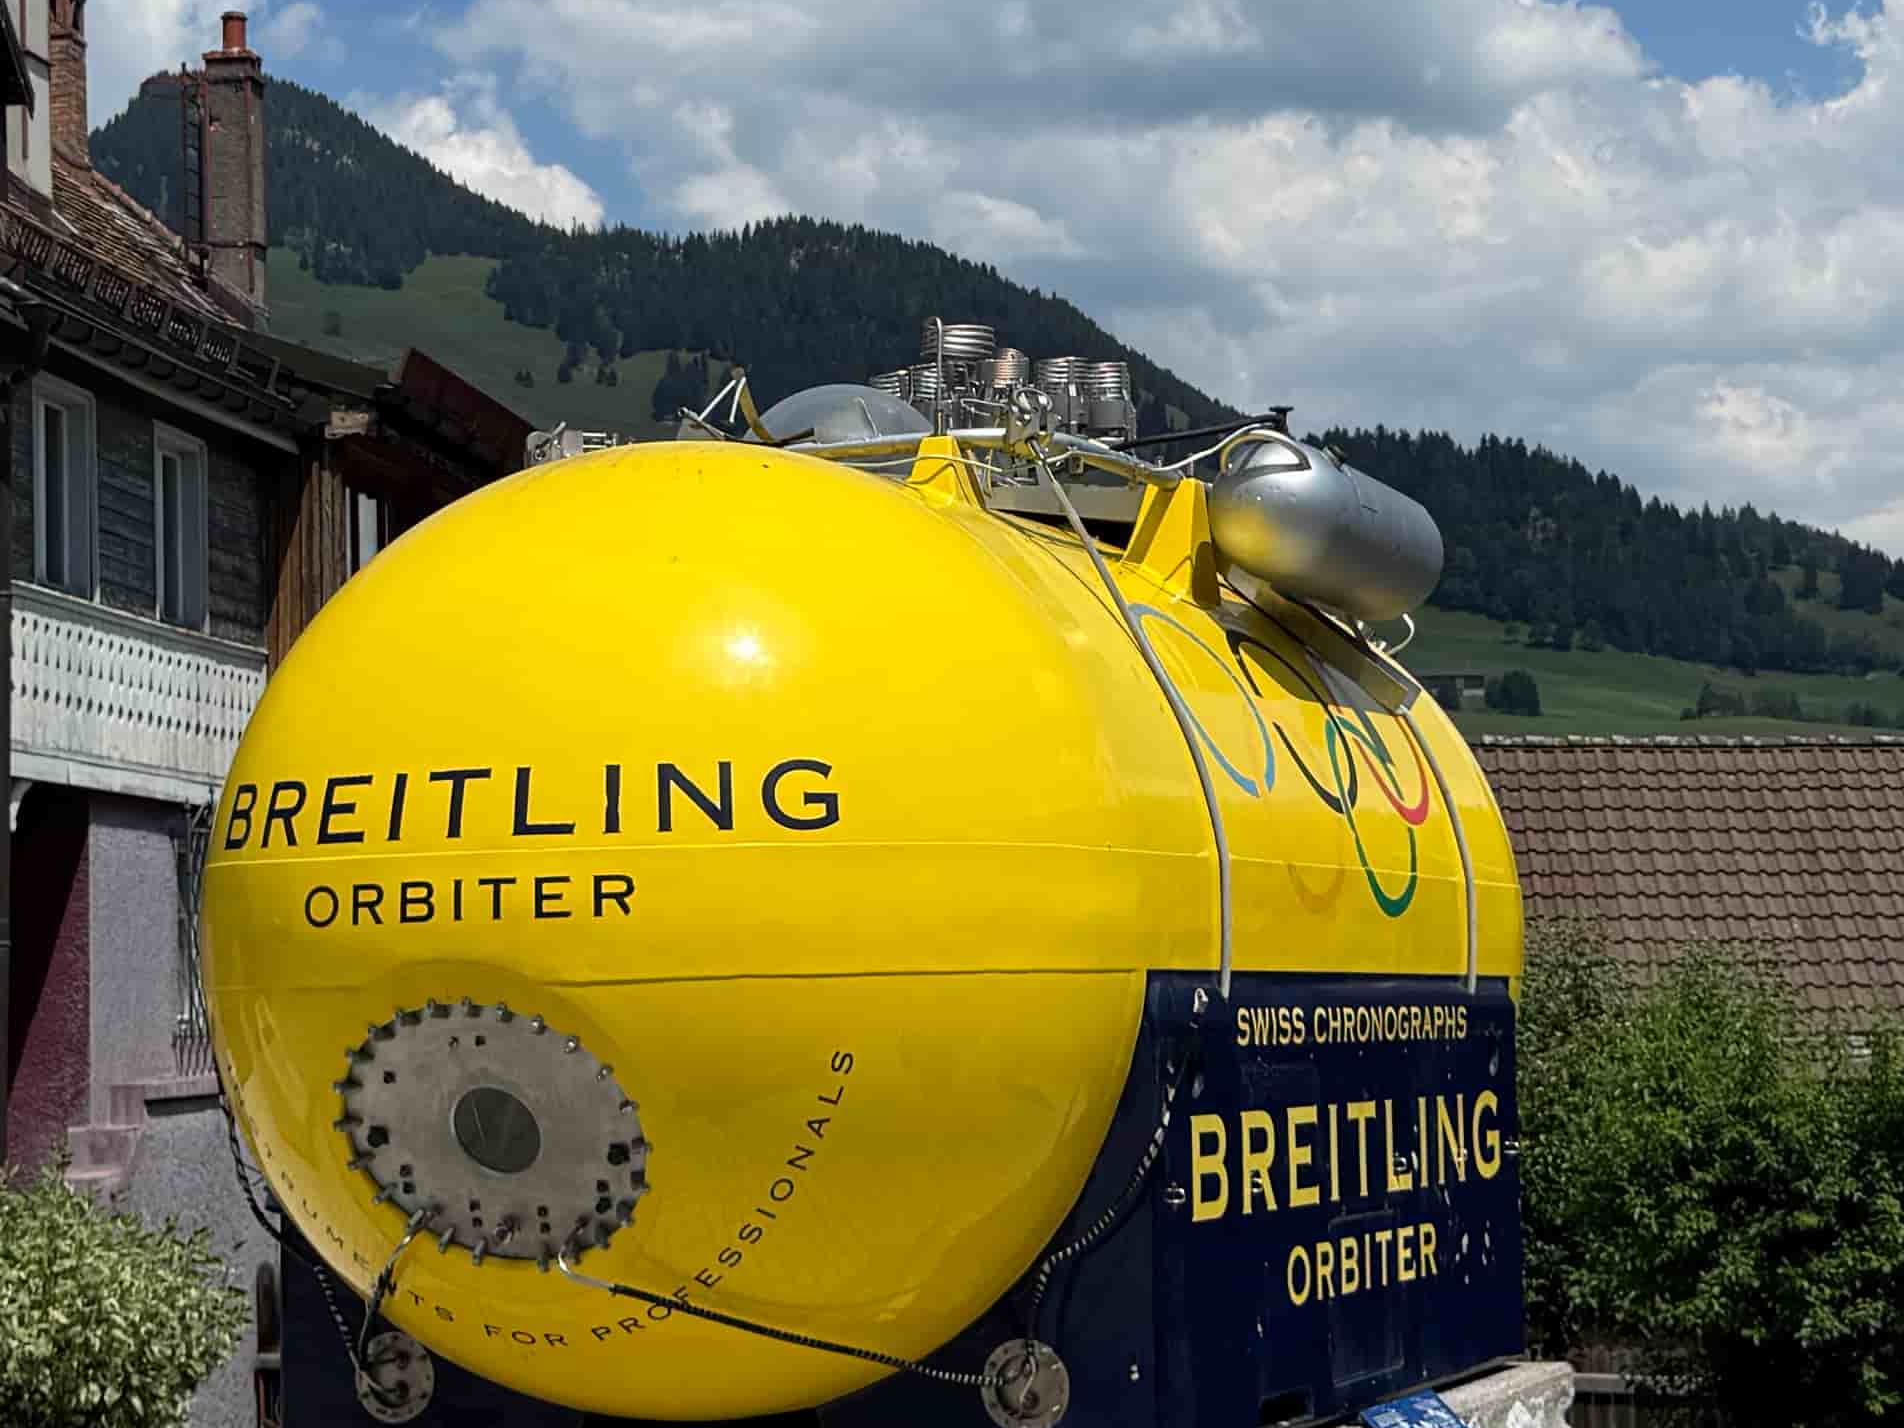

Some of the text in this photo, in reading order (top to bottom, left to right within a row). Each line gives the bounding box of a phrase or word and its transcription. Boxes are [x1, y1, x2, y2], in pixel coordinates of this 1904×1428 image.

[223, 759, 841, 851] BREITLING
[303, 874, 636, 928] ORBITER
[1236, 1003, 1468, 1047] SWISS CHRONOGRAPHS
[484, 1323, 568, 1347] FOR
[591, 1051, 854, 1341] PROFESSIONALS
[1190, 1090, 1502, 1223] BREITLING
[1287, 1221, 1438, 1306] ORBITER
